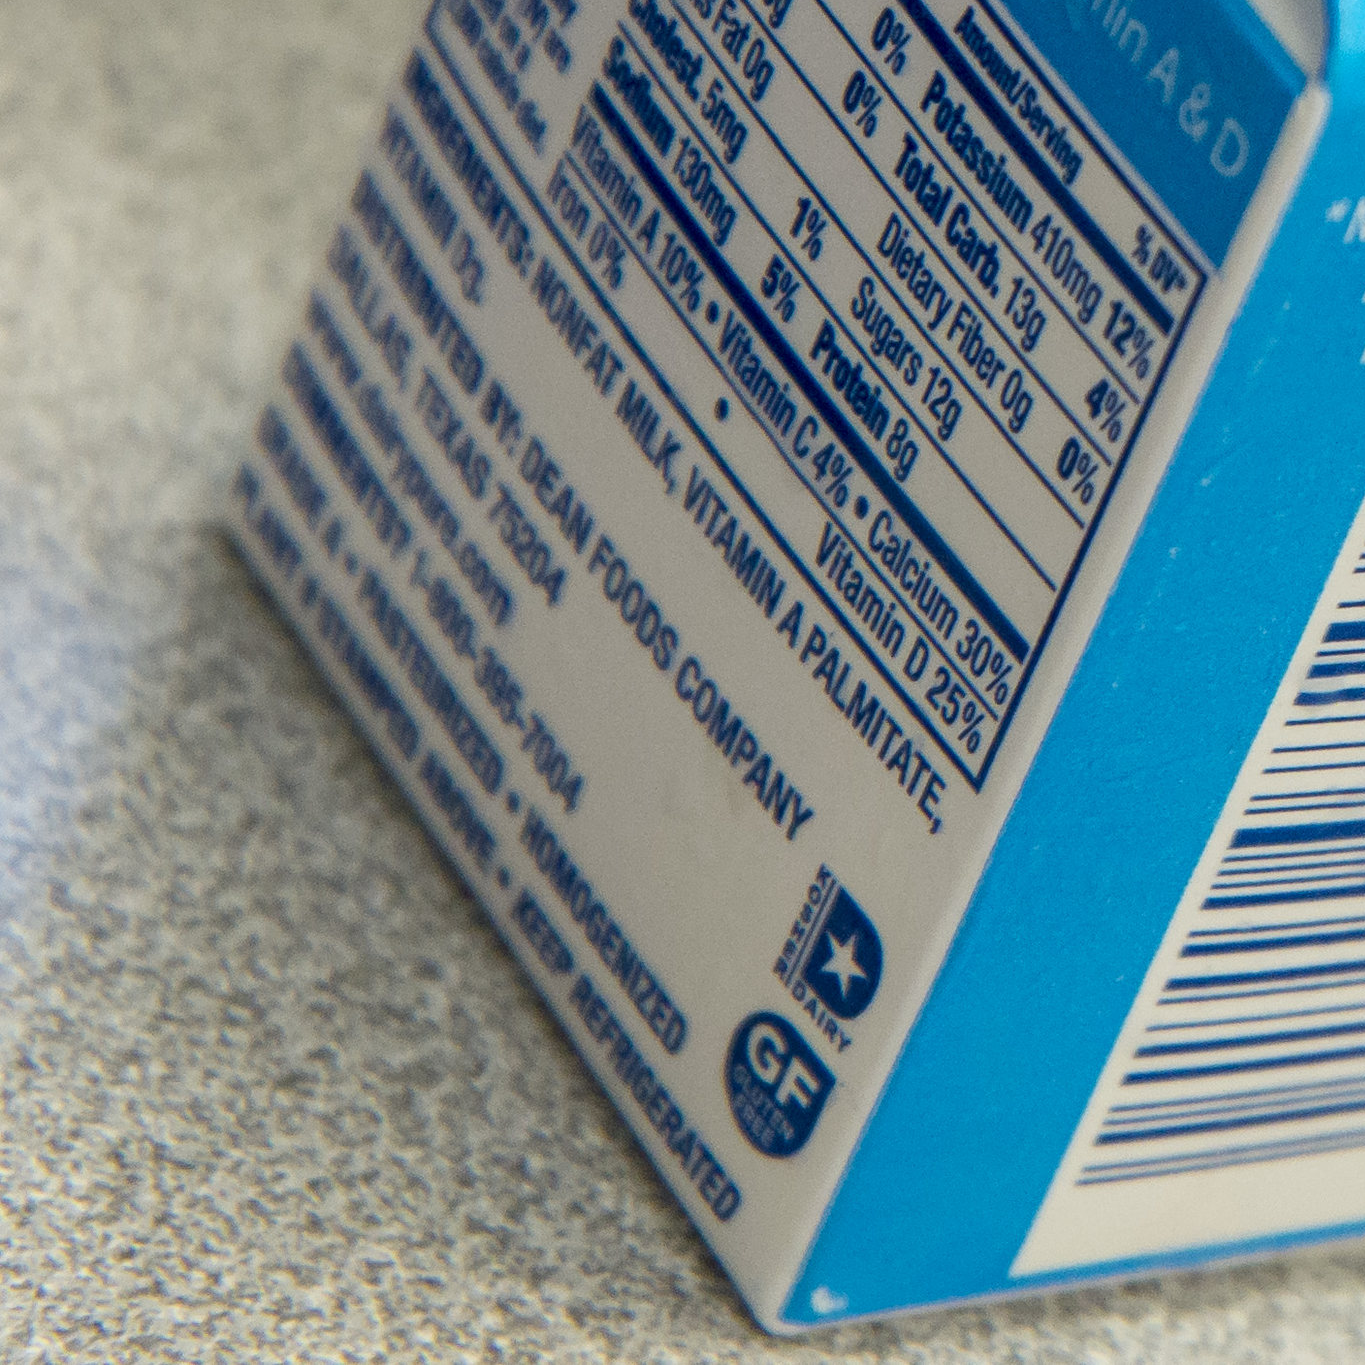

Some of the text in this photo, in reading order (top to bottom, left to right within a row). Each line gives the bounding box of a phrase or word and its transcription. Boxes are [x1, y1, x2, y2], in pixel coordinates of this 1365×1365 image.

[742, 36, 776, 103] 0g
[842, 69, 883, 138] 0%
[871, 6, 911, 76] 0%
[954, 6, 1083, 186] Amount/Serving
[604, 37, 738, 248] Sodium 130mg
[700, 77, 749, 165] 5mg
[1147, 46, 1180, 102] A
[1177, 81, 1211, 142] &
[1208, 116, 1250, 178] D
[383, 113, 460, 248] VITAMIN
[547, 158, 627, 290] Iron 0%
[790, 196, 828, 261] 1%
[894, 132, 1047, 354] Total Carb. 13g
[920, 70, 1104, 325] Potassium 410mg
[1132, 224, 1153, 266] %
[760, 254, 801, 323] 5%
[877, 212, 1035, 434] Dietary Fiber 0g
[1103, 299, 1154, 379] 12%
[572, 106, 1013, 705] Vitamin A 10% Vitamin C 4% Calcium 30%
[810, 319, 920, 483] Protein 8g
[850, 275, 963, 442] Sugars 12g
[1084, 377, 1126, 443] 4%
[354, 172, 814, 839] DISTRIBUTED BY: DEAN FOODS COMPANY
[405, 52, 534, 274] INGREDIENTS:
[532, 258, 625, 394] NONFAT
[616, 378, 682, 493] MILK,
[684, 466, 786, 617] VITAMIN
[776, 599, 805, 648] A
[800, 623, 946, 833] PALMITATE,
[417, 369, 493, 499] TEXAS
[489, 482, 567, 605] 75204
[1056, 435, 1099, 505] 0%
[816, 510, 985, 754] Vitamin D 25%
[522, 810, 688, 1053] HOMOGENIZED
[511, 888, 741, 1220] KEEP REFRIGERATED
[750, 1018, 820, 1107] GF
[792, 979, 854, 1052] DAIRY
